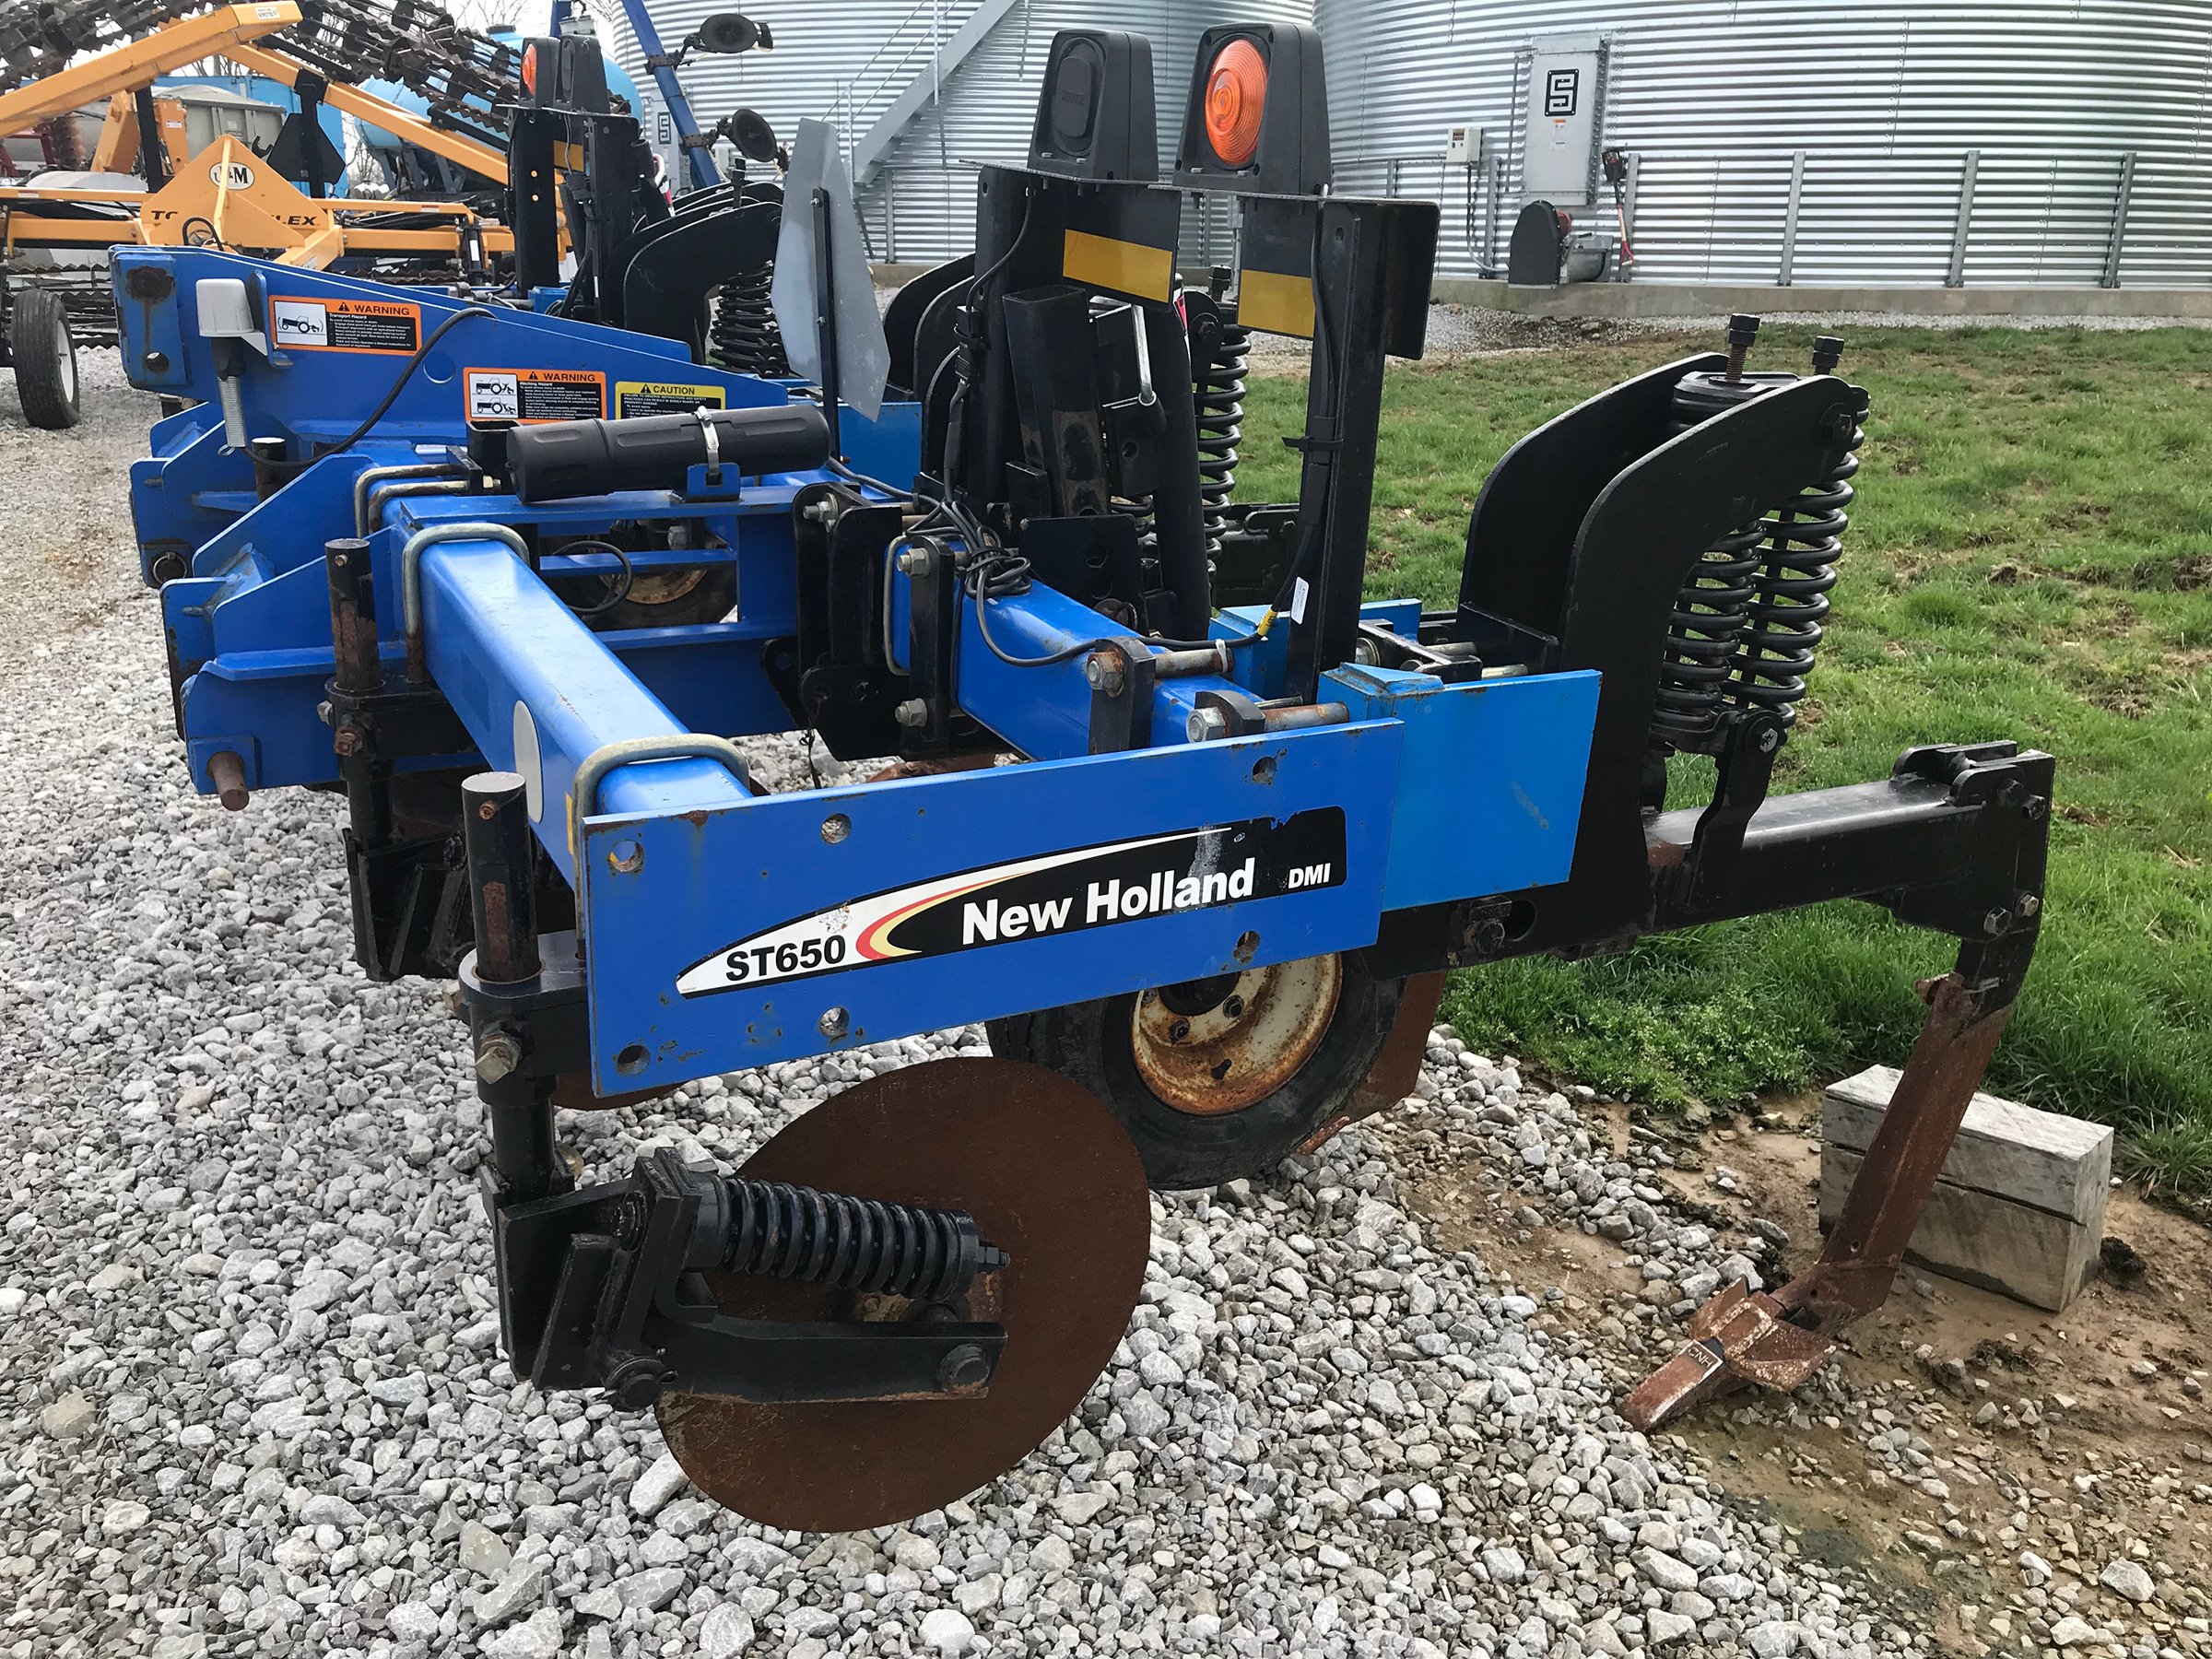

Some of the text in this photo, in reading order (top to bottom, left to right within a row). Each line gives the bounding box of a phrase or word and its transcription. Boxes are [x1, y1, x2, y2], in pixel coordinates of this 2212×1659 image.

[354, 305, 410, 315] WARNING
[543, 373, 595, 382] WARNING
[653, 385, 695, 395] CAUTION
[725, 857, 1332, 982] ST650 New Holland DMI
[1688, 1347, 1713, 1368] CNH
